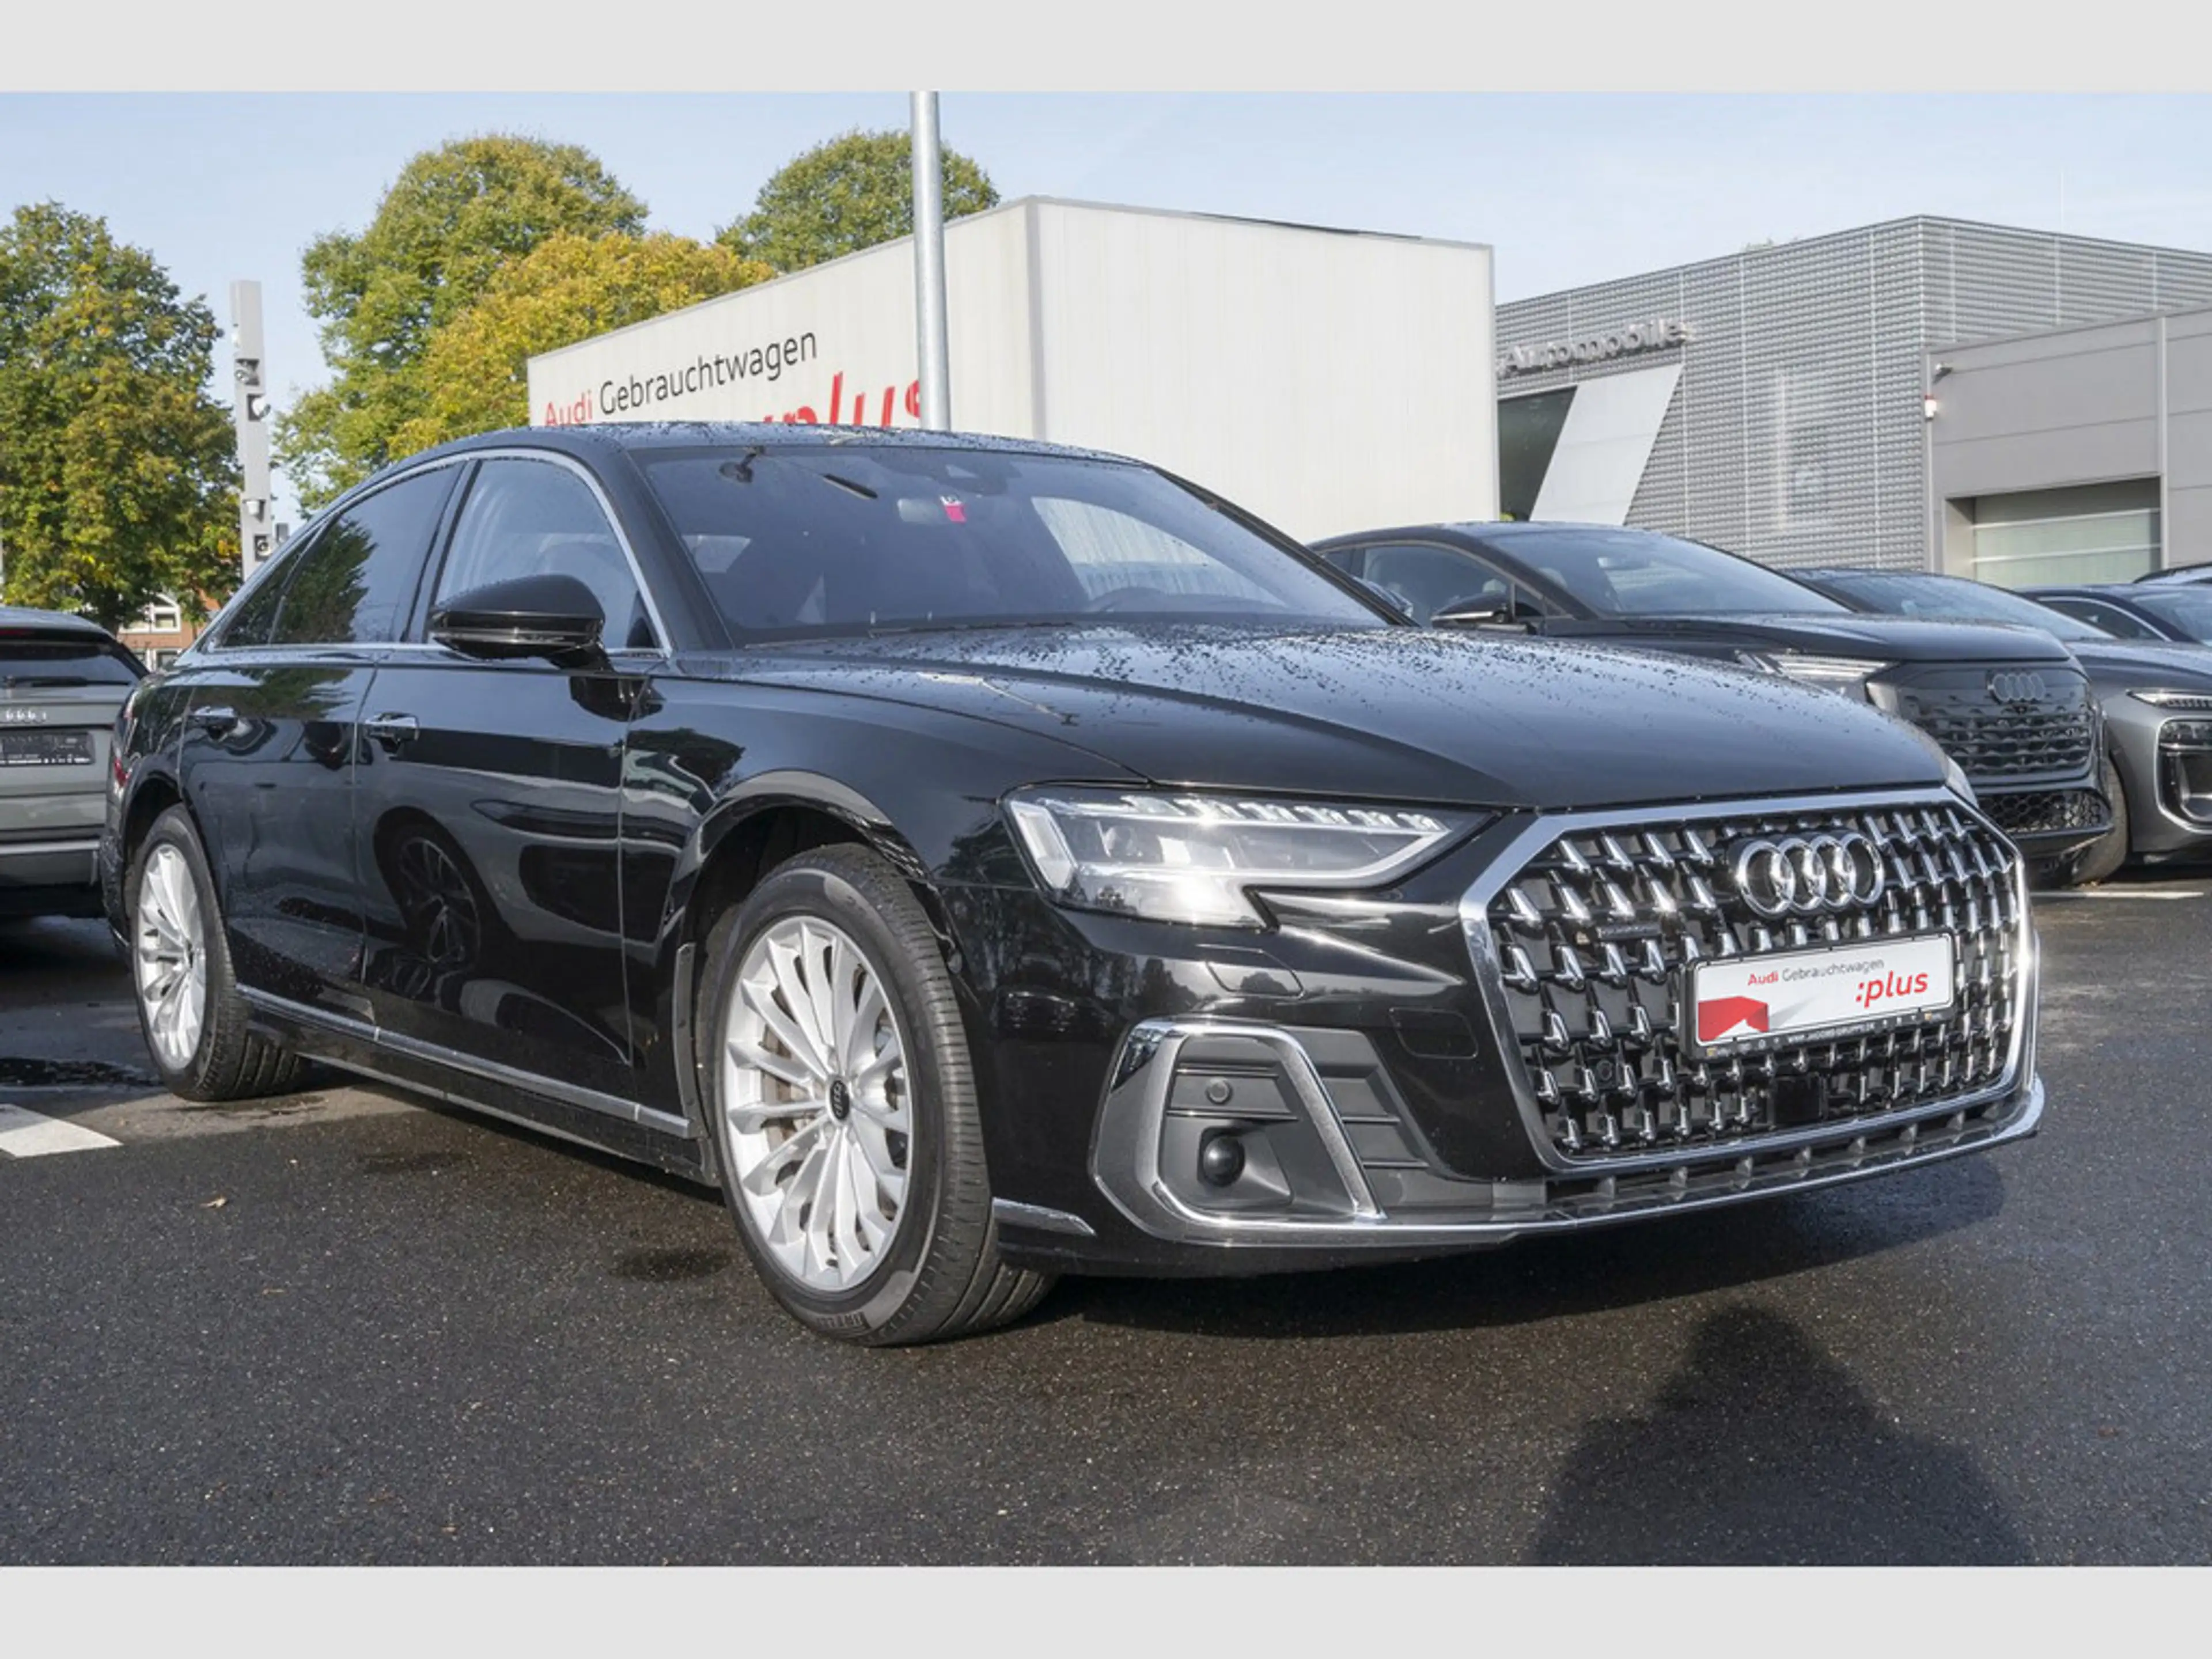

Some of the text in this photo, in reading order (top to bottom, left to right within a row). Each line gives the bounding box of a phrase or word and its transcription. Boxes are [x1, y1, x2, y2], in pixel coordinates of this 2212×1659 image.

[545, 390, 593, 426] Audi
[600, 332, 816, 415] Gebrauchtwagen
[1747, 971, 1778, 986] Audi
